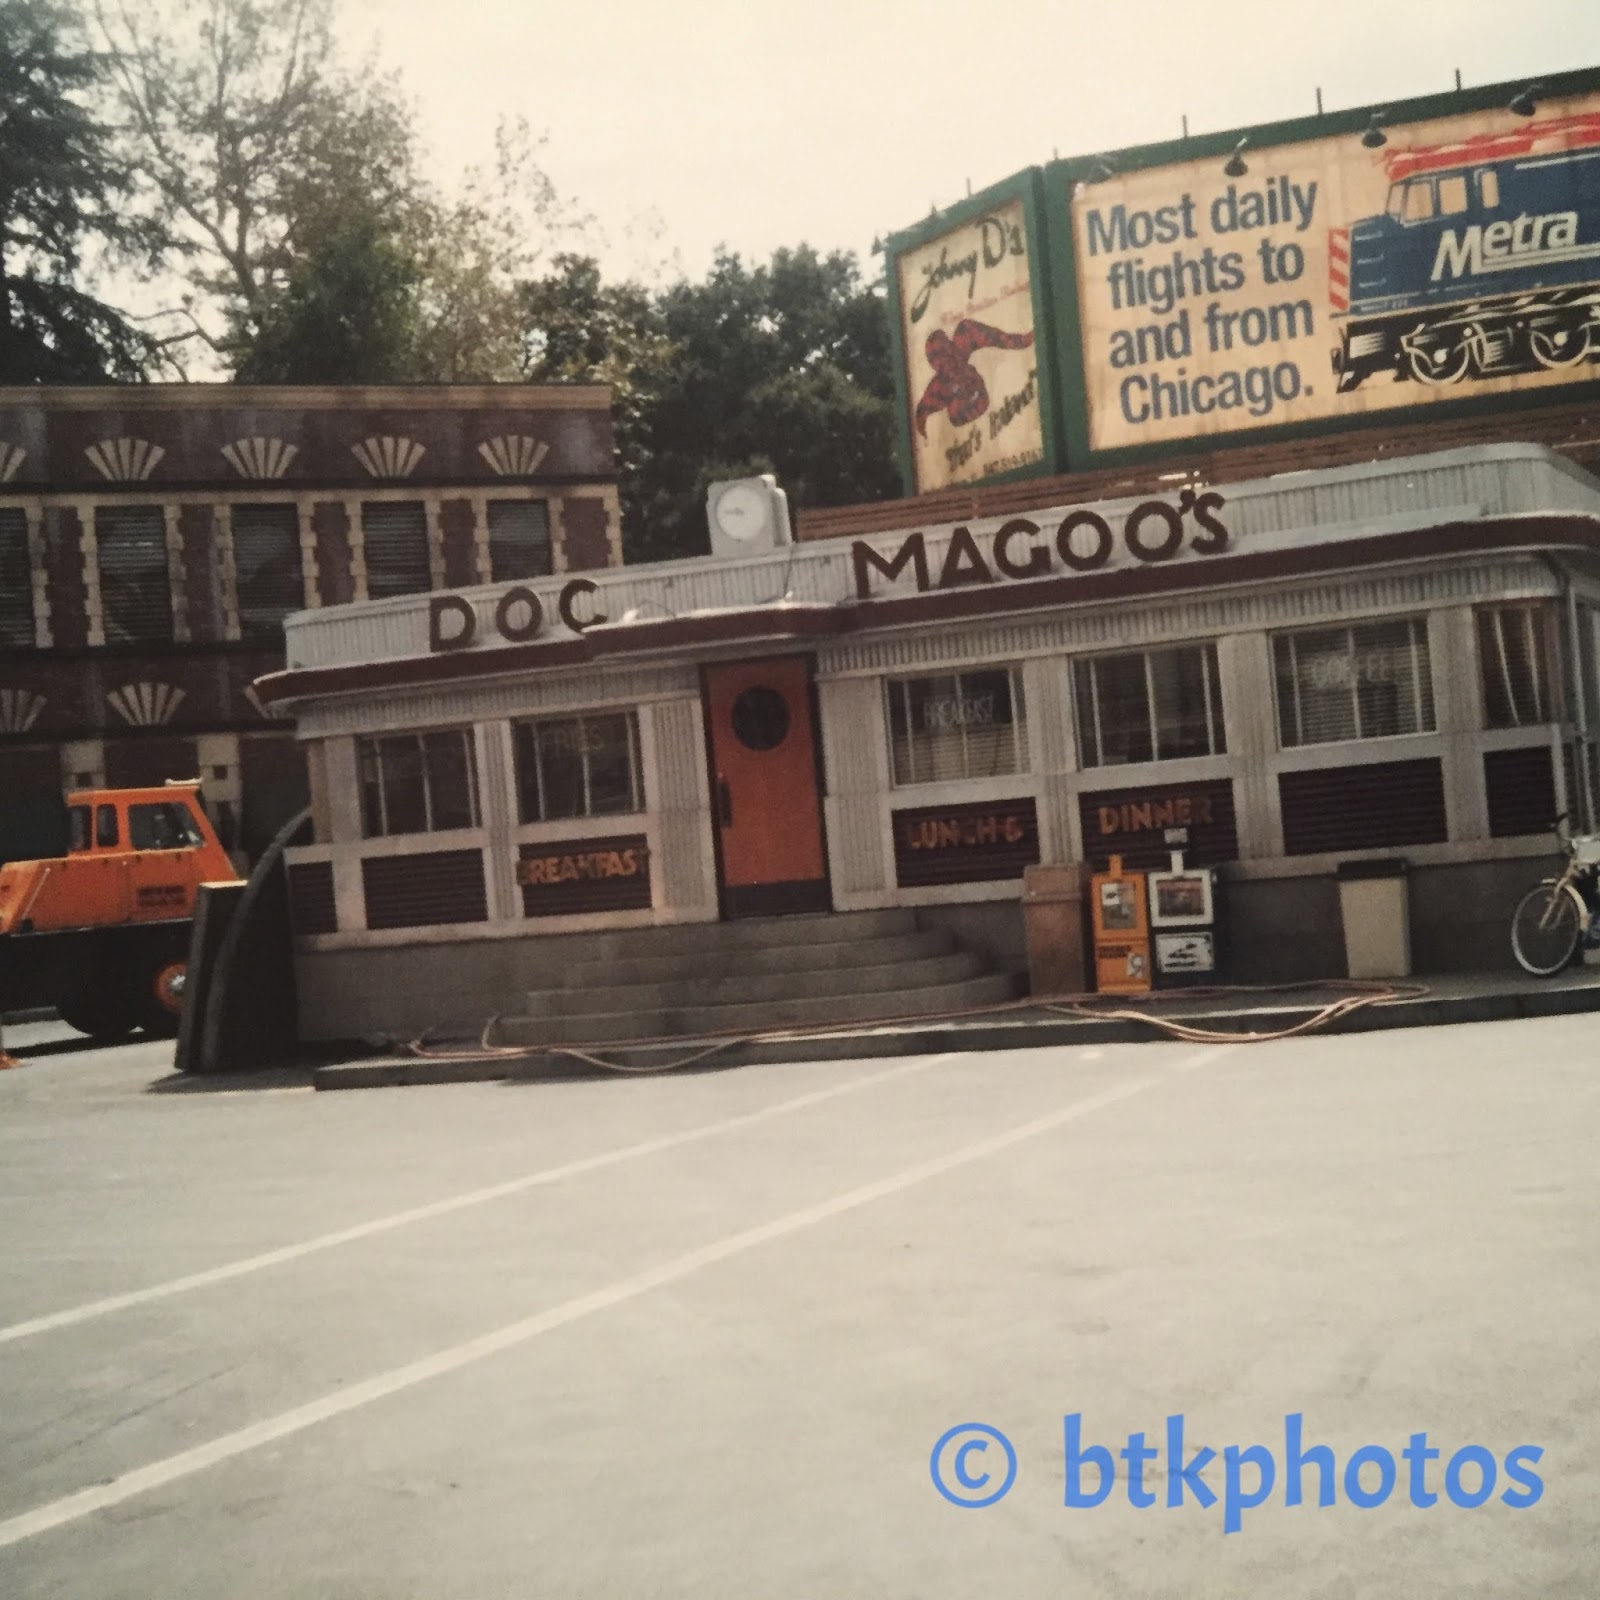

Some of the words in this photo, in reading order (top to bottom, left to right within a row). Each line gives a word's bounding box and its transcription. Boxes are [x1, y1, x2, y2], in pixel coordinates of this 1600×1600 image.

[1086, 193, 1197, 256] Most
[1210, 176, 1317, 232] daily
[1430, 211, 1578, 281] Metra
[1107, 247, 1244, 314] flights
[1257, 238, 1304, 284] to
[1109, 309, 1193, 368] and
[1204, 300, 1314, 352] from
[1120, 361, 1314, 424] Chicago.
[429, 578, 609, 653] DOC
[852, 489, 1229, 599] MAGOO'S
[1097, 796, 1214, 834] DINNER
